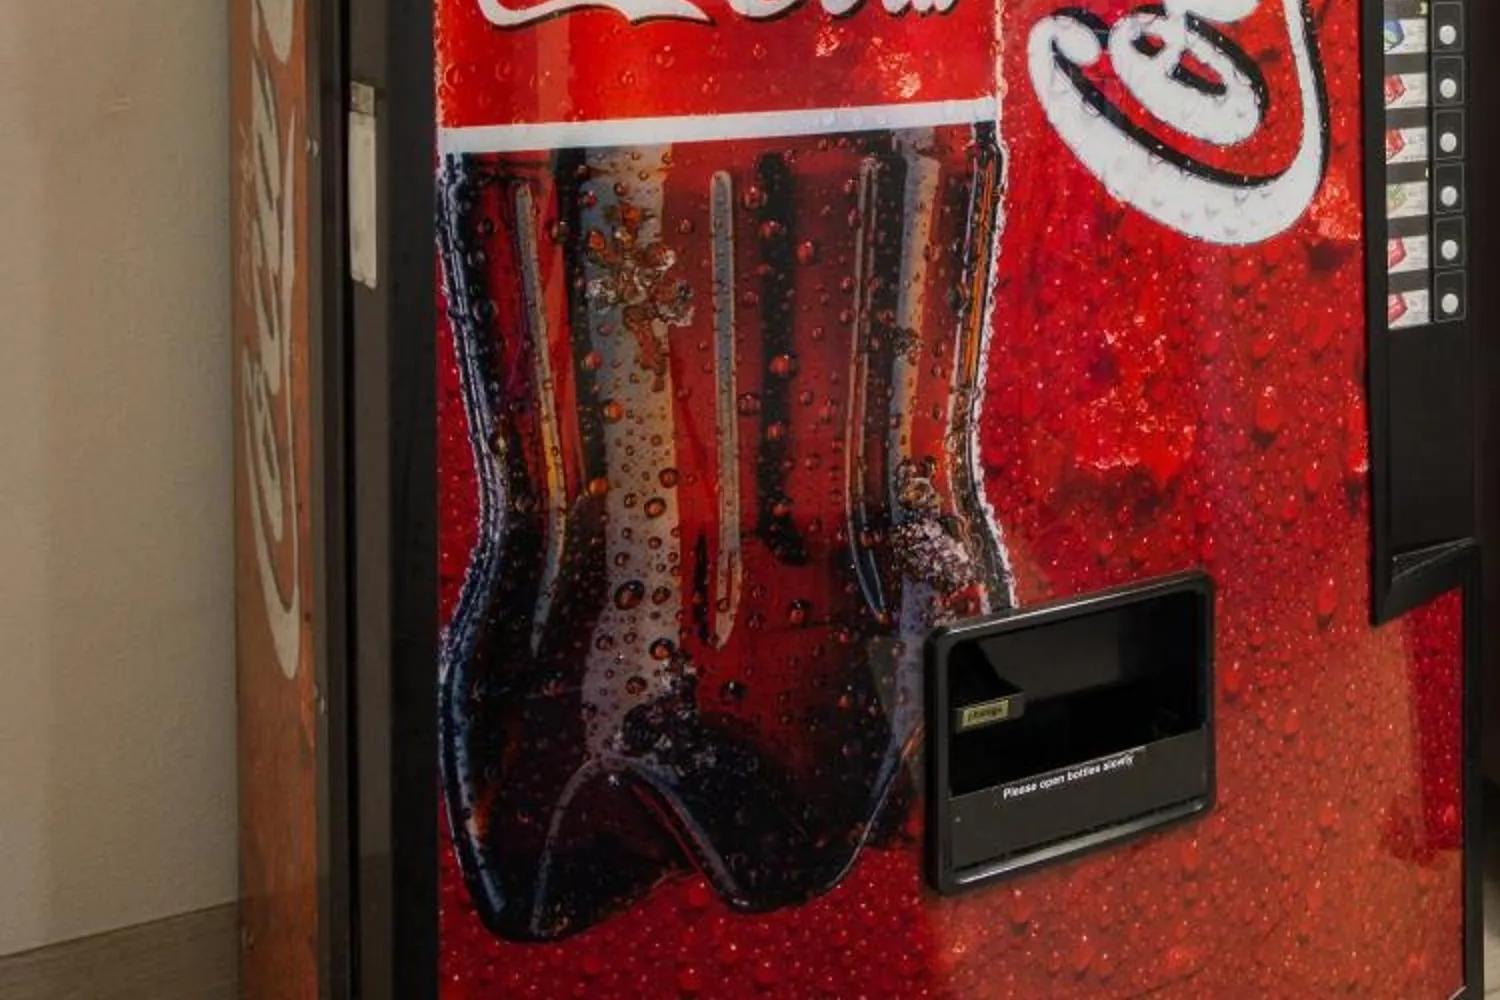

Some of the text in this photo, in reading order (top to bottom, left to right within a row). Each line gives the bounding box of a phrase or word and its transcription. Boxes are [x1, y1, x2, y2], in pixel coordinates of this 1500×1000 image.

[1002, 781, 1038, 800] Please
[1039, 774, 1065, 789] open
[1067, 765, 1100, 781] bottles
